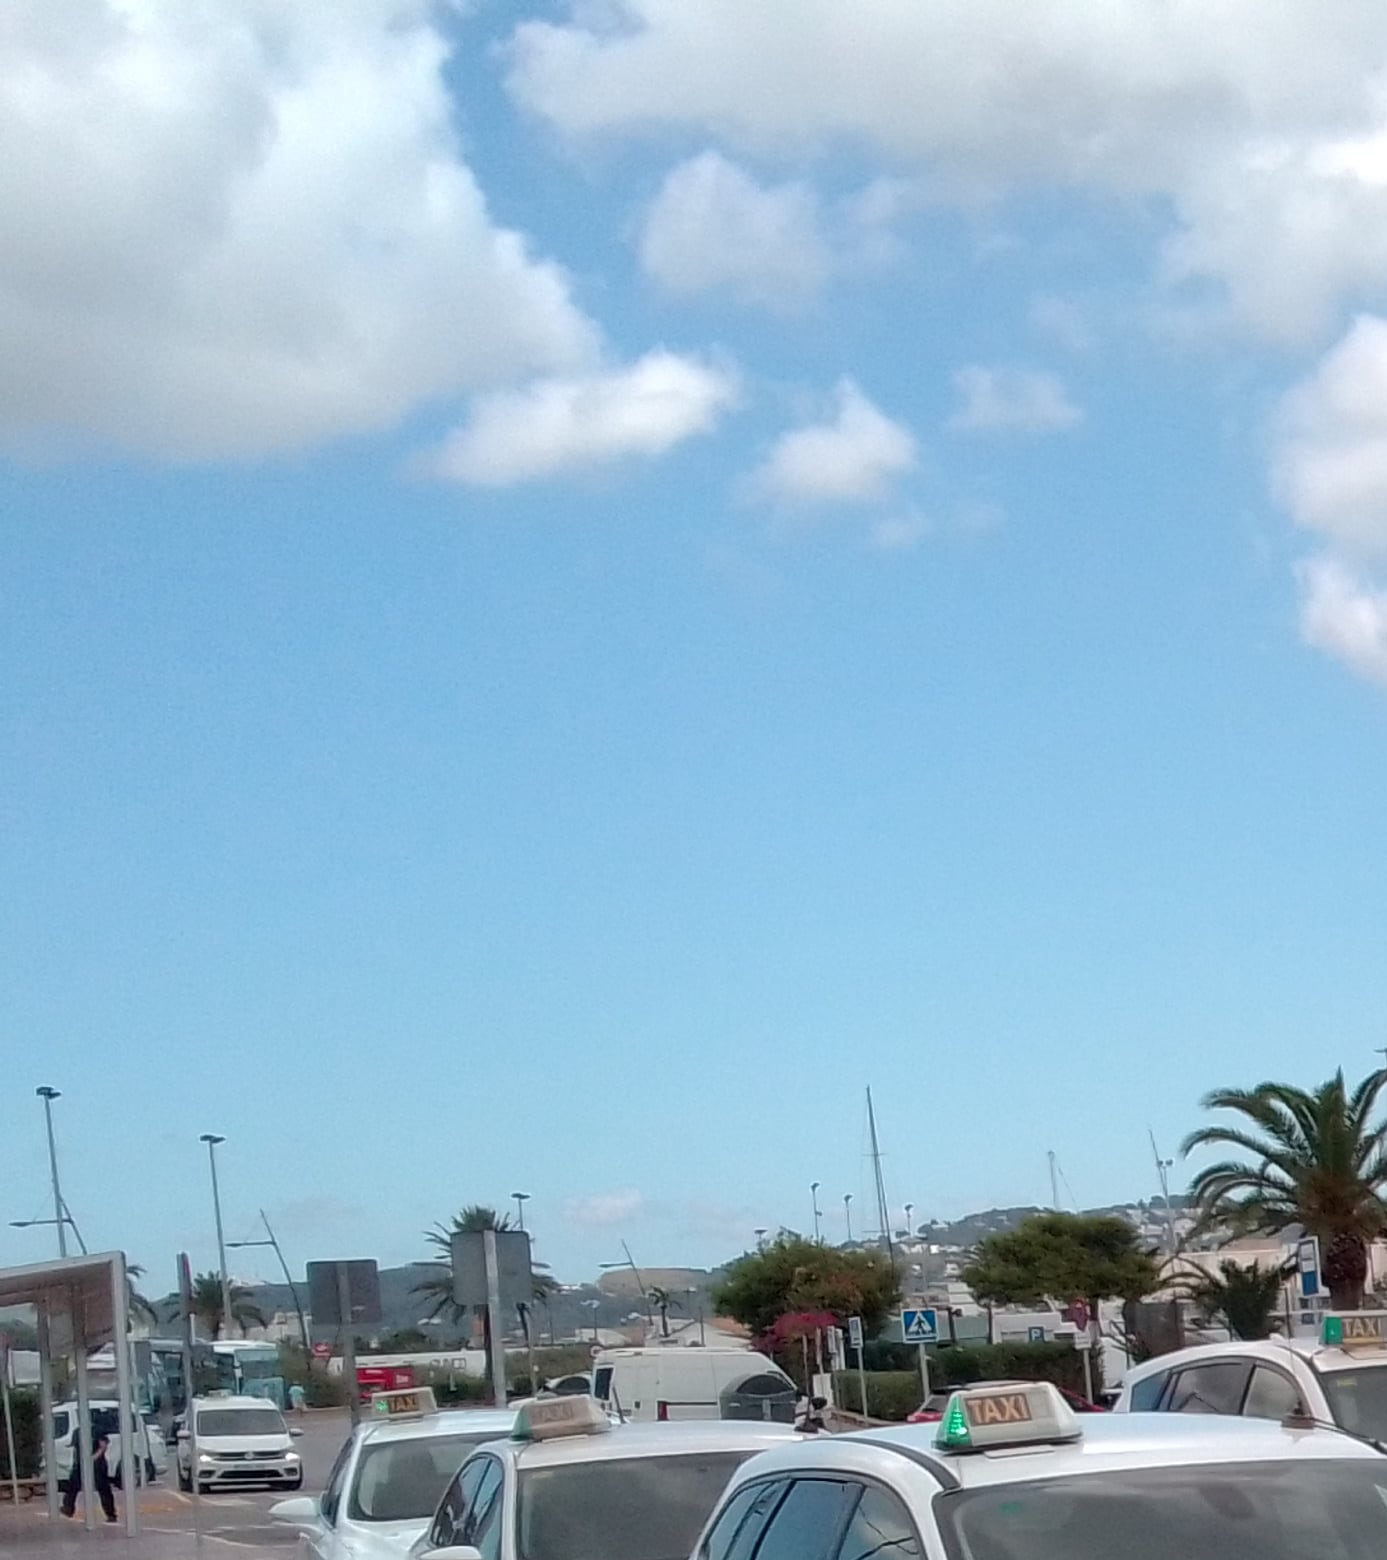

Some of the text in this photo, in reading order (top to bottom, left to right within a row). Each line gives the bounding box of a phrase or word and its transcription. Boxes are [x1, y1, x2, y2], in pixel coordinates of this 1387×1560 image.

[1344, 1318, 1381, 1336] TAXI
[388, 1395, 416, 1412] TAXI
[967, 1395, 1029, 1423] TAXI
